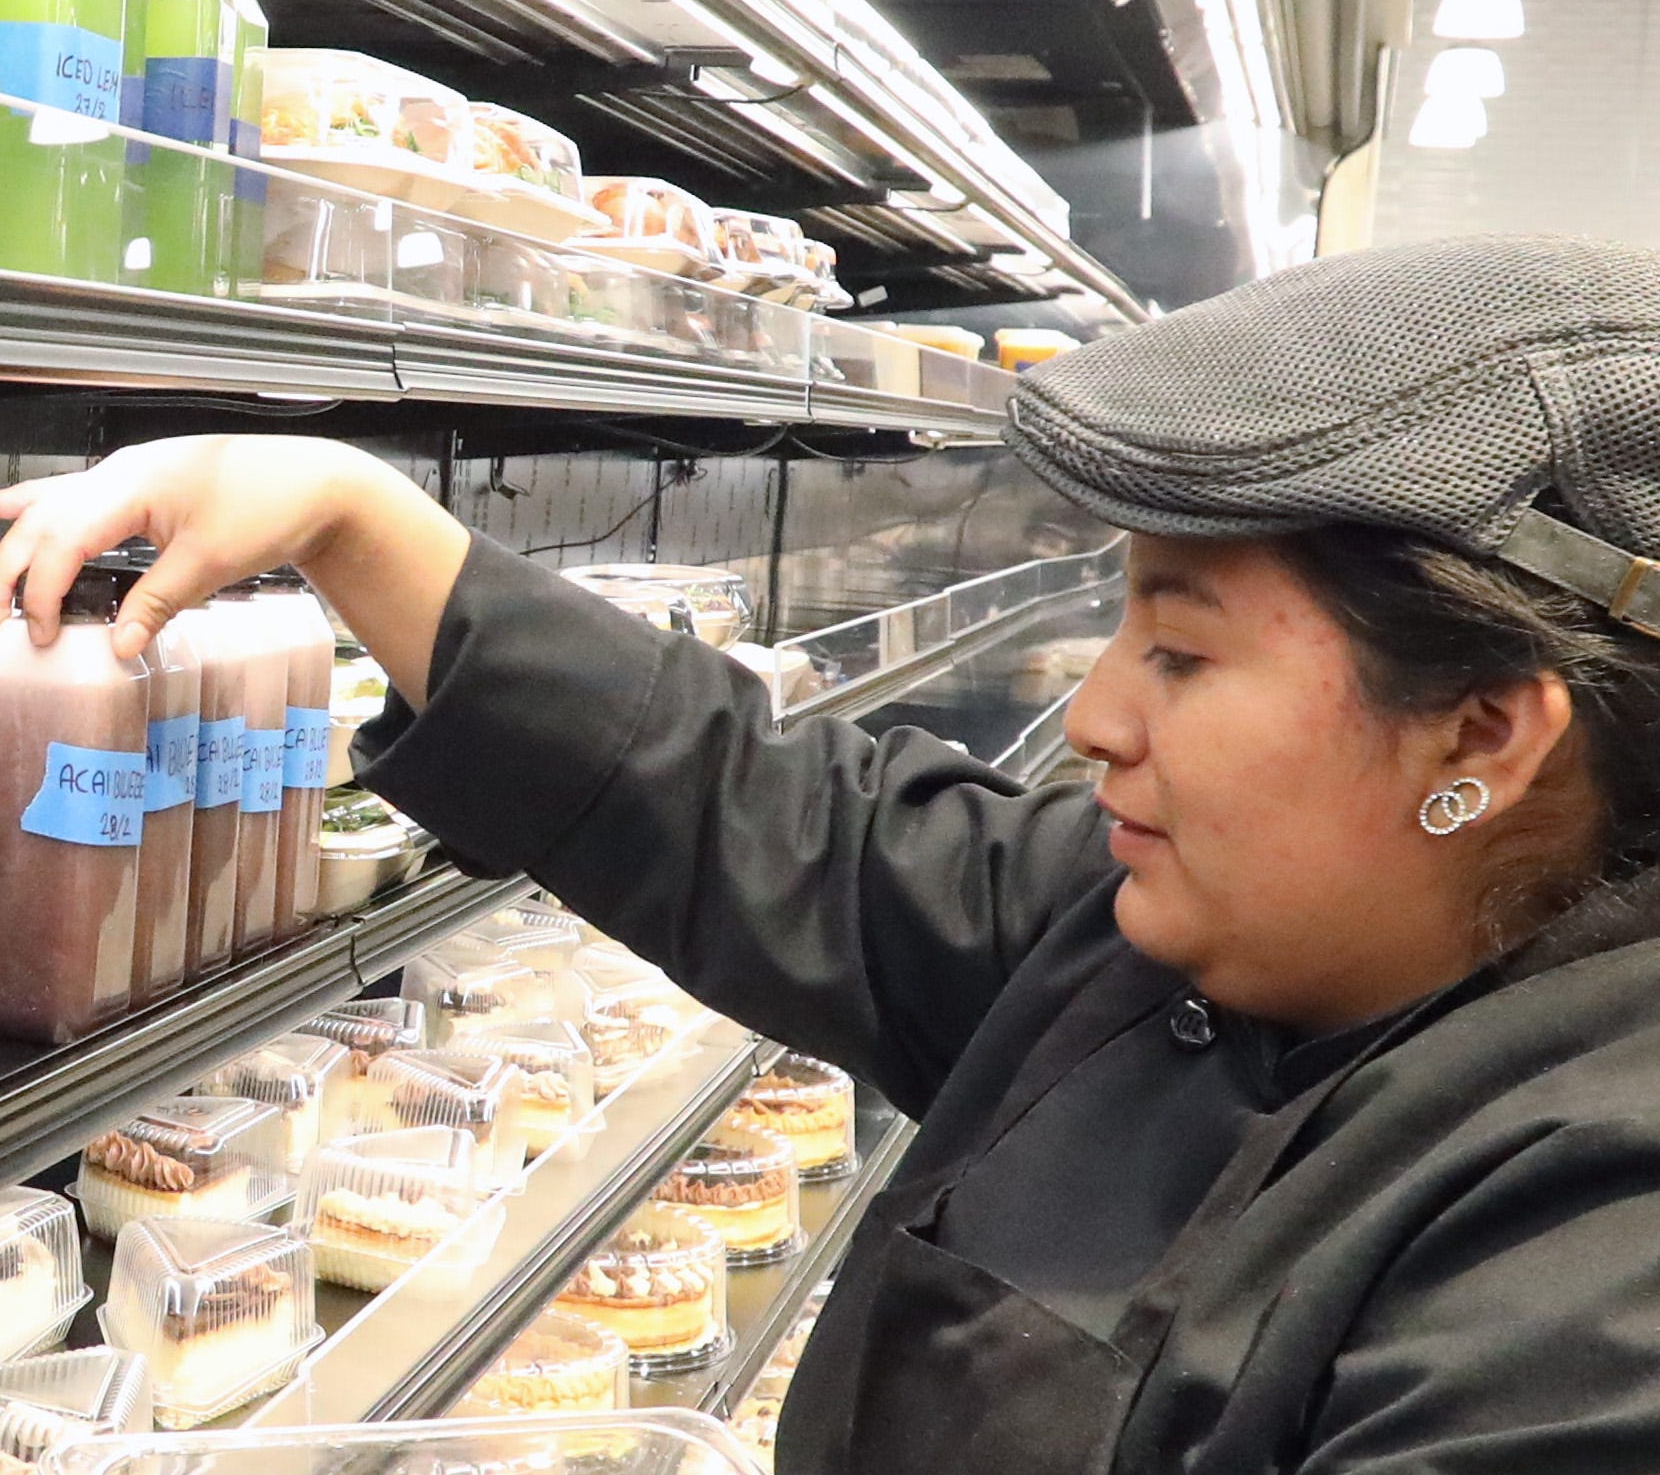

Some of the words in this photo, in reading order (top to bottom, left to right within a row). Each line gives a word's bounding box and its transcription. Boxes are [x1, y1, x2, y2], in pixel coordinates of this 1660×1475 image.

[74, 93, 107, 120] 27/2
[59, 763, 110, 796] ACAI
[100, 812, 131, 841] 28/2
